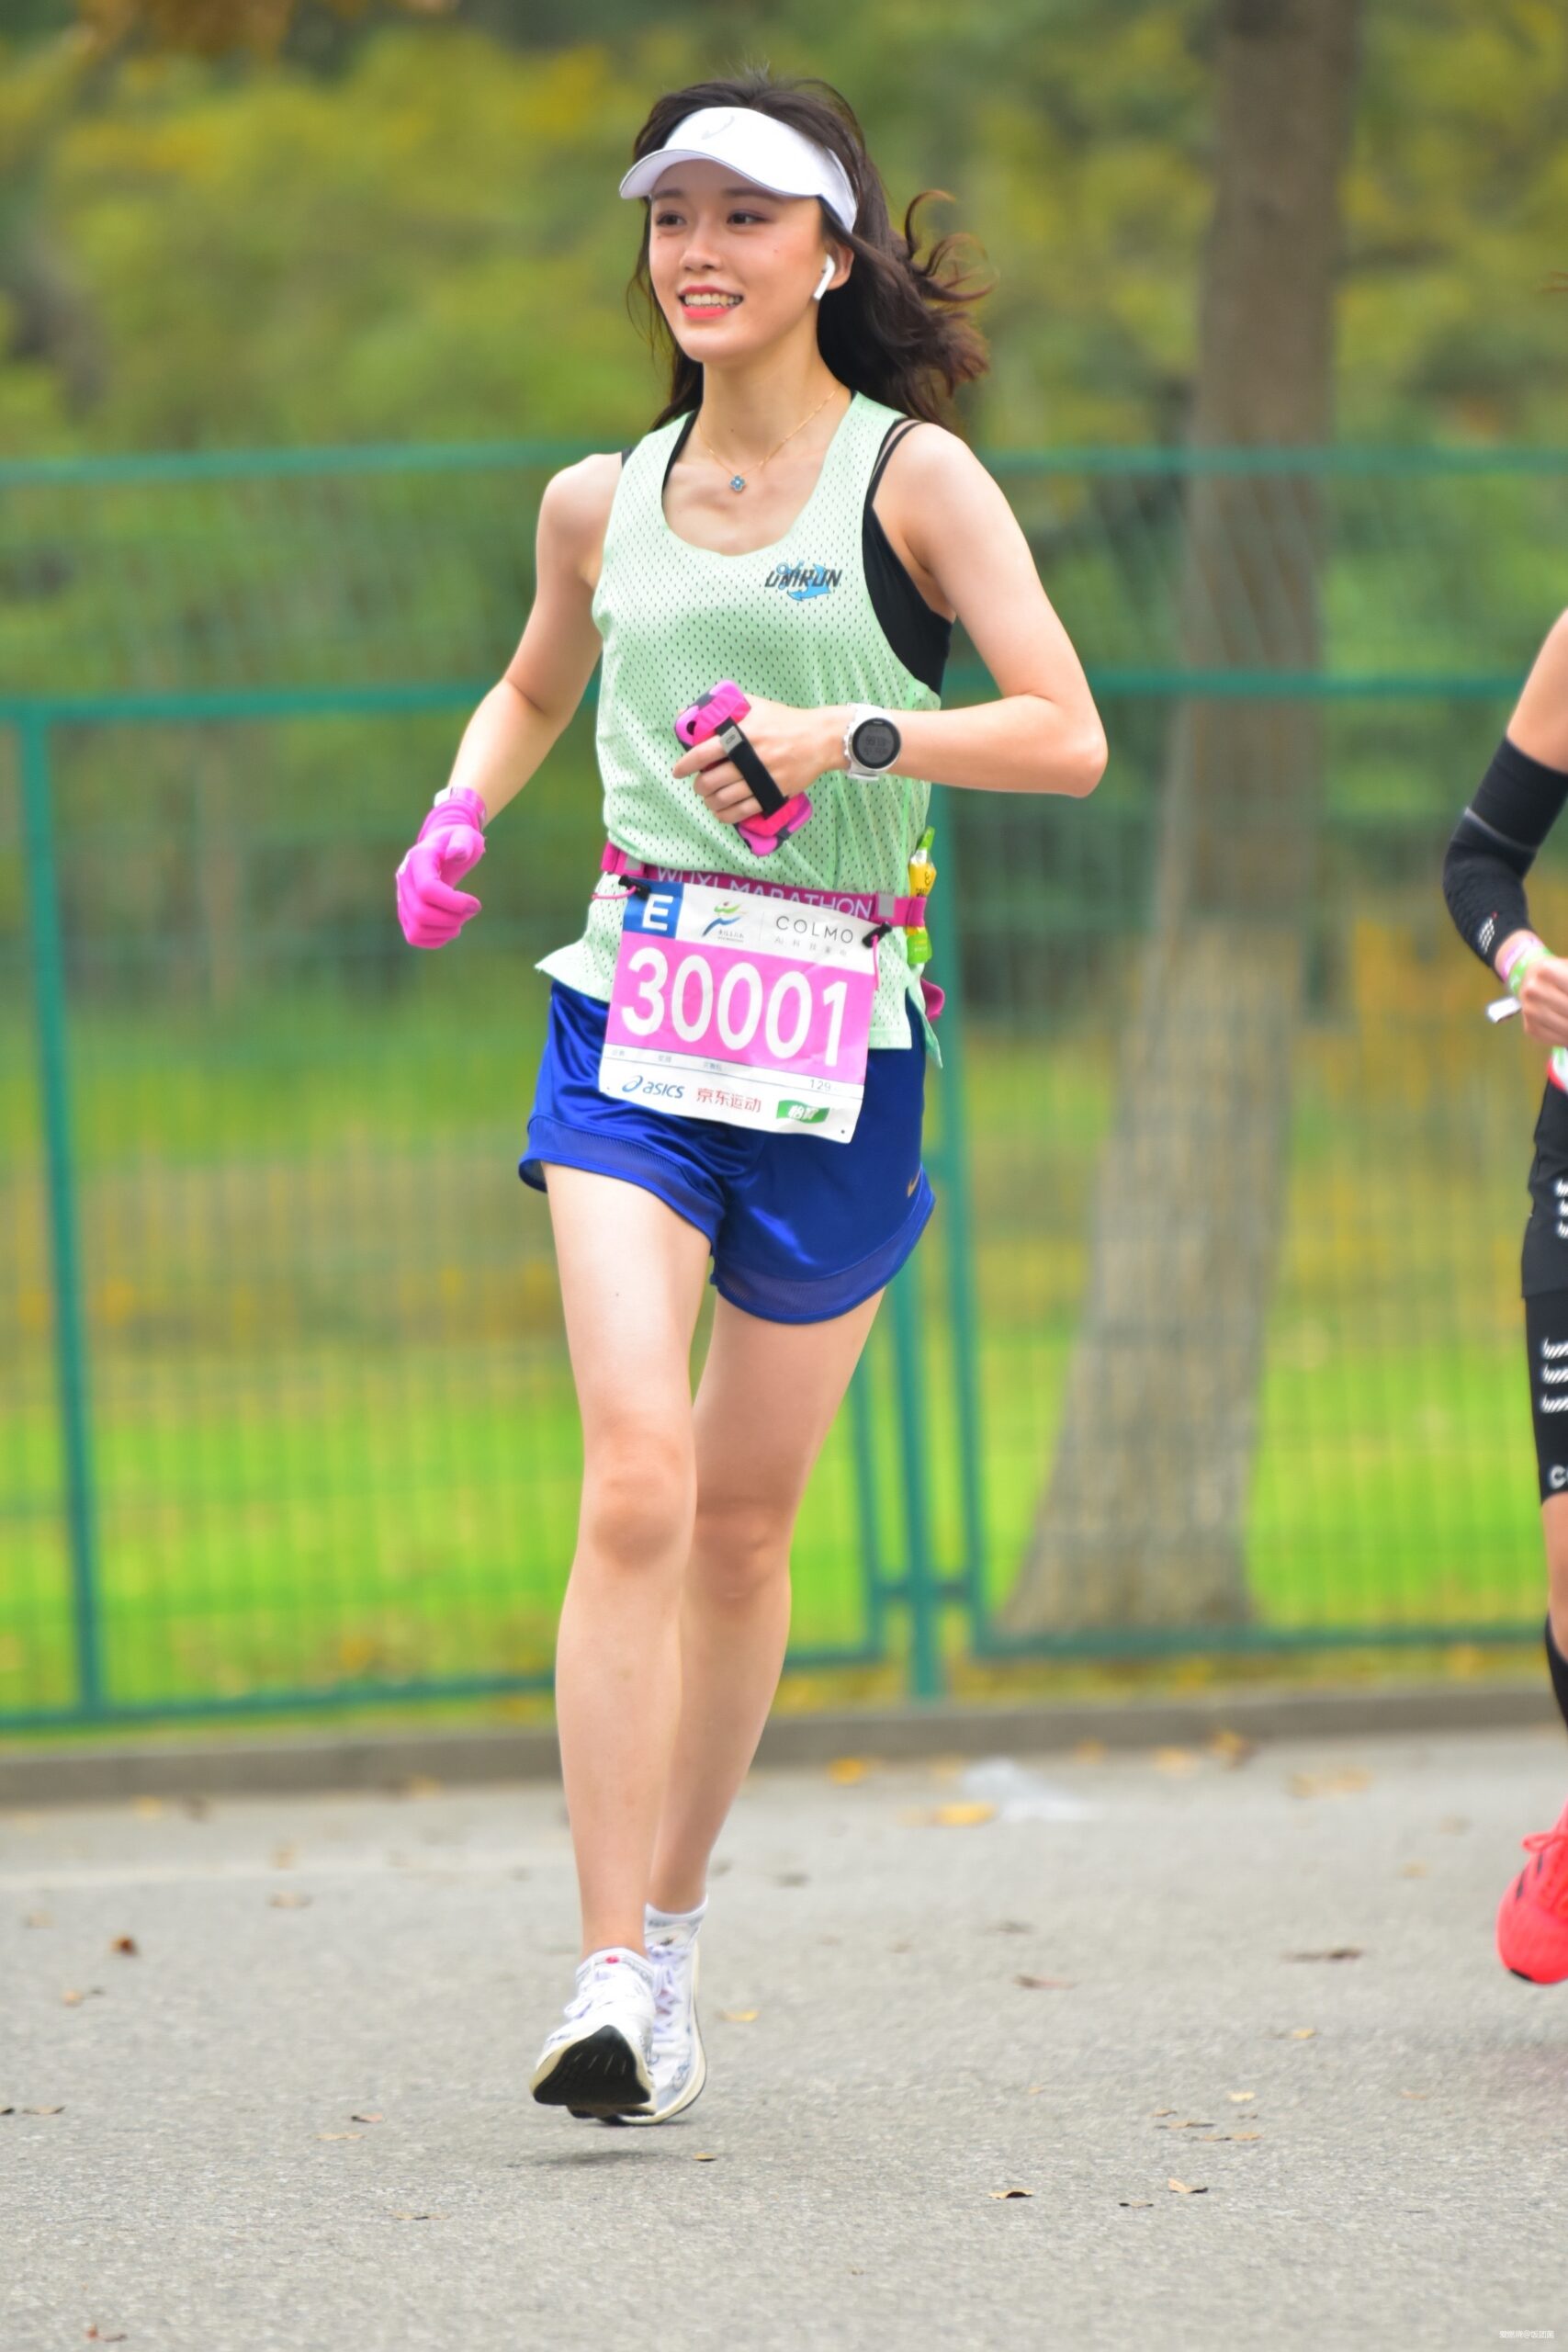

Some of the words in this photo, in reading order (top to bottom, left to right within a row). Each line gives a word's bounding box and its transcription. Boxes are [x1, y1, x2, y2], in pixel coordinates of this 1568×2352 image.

[641, 894, 673, 931] E
[776, 915, 853, 944] COLMO
[621, 946, 847, 1067] 30001
[696, 1087, 761, 1114] 京东运动
